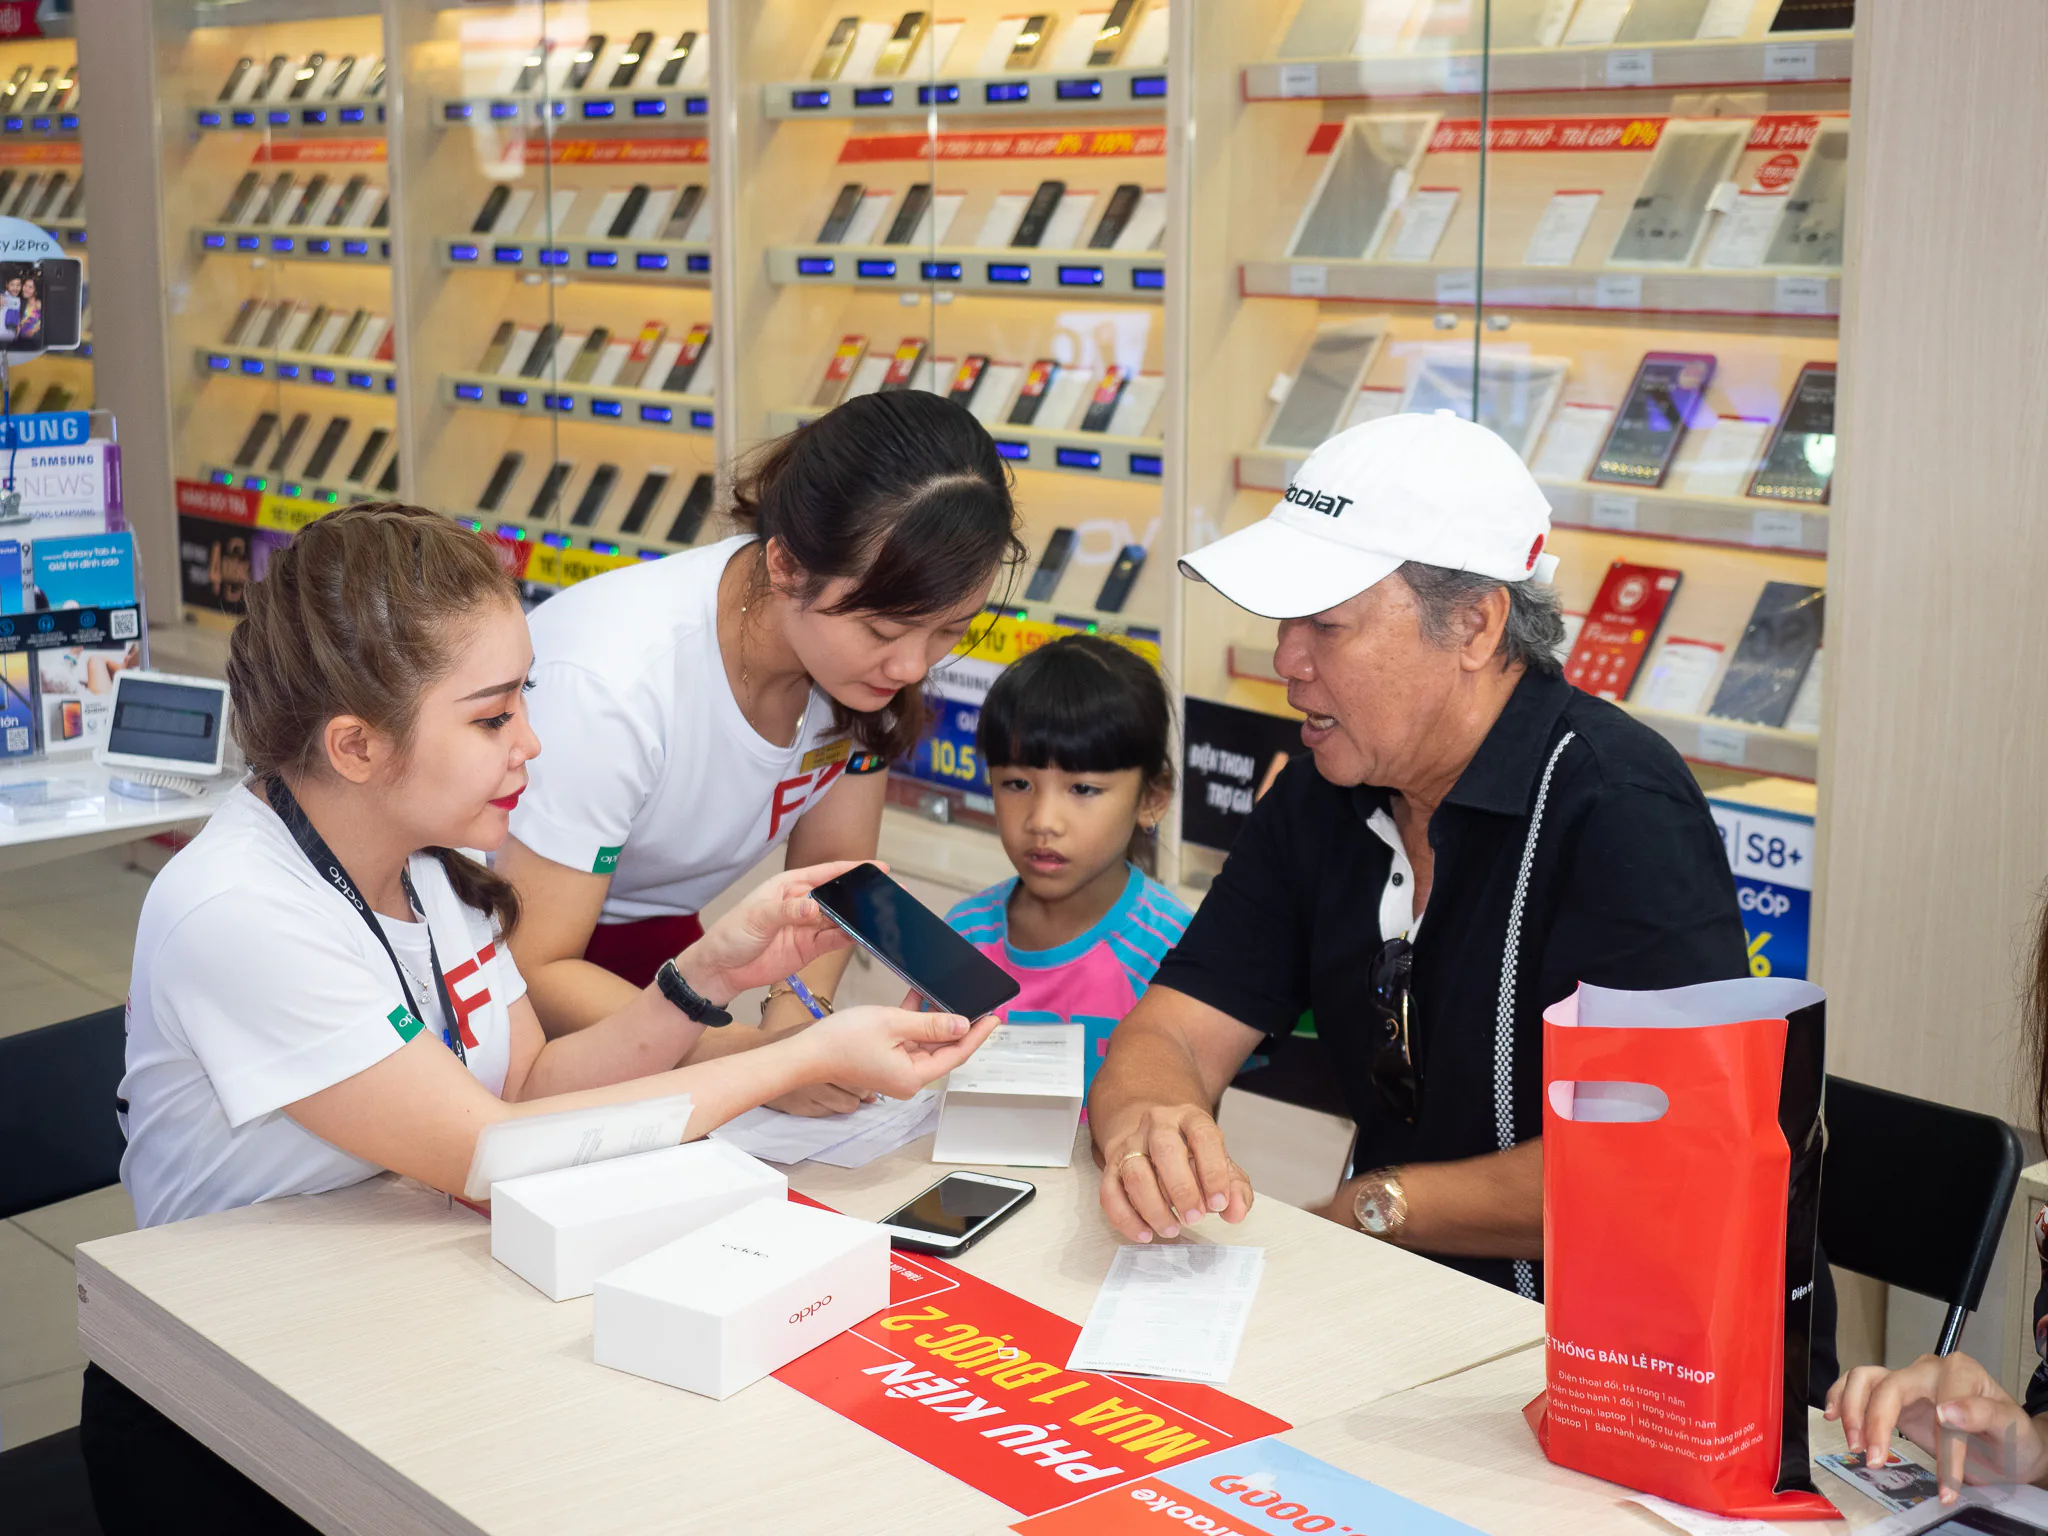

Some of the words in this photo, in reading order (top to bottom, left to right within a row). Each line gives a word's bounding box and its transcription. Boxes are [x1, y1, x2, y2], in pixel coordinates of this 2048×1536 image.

[1620, 121, 1661, 146] 0%
[28, 240, 50, 252] Pro
[31, 454, 94, 468] SAMSUNG
[24, 473, 95, 499] NEWS
[930, 737, 977, 780] 10.5
[1746, 832, 1803, 869] S8+
[329, 866, 364, 911] oppo
[789, 1295, 832, 1324] oppo
[879, 1305, 949, 1331] 2
[1551, 1337, 1596, 1361] THỐNG
[1598, 1349, 1629, 1366] BÁN
[1631, 1352, 1648, 1369] LẺ
[1650, 1358, 1674, 1375] FPT
[1677, 1365, 1716, 1384] SHOP
[861, 1360, 1006, 1422] KIỆN
[1028, 1380, 1091, 1405] 1
[1558, 1370, 1577, 1383] Điện
[1636, 1386, 1660, 1401] trong
[1554, 1413, 1581, 1428] laptop
[1642, 1403, 1664, 1418] trong
[1068, 1396, 1210, 1464] MUA
[1597, 1408, 1627, 1422] laptop
[1691, 1435, 1712, 1446] mua
[980, 1424, 1125, 1484] PHỤ
